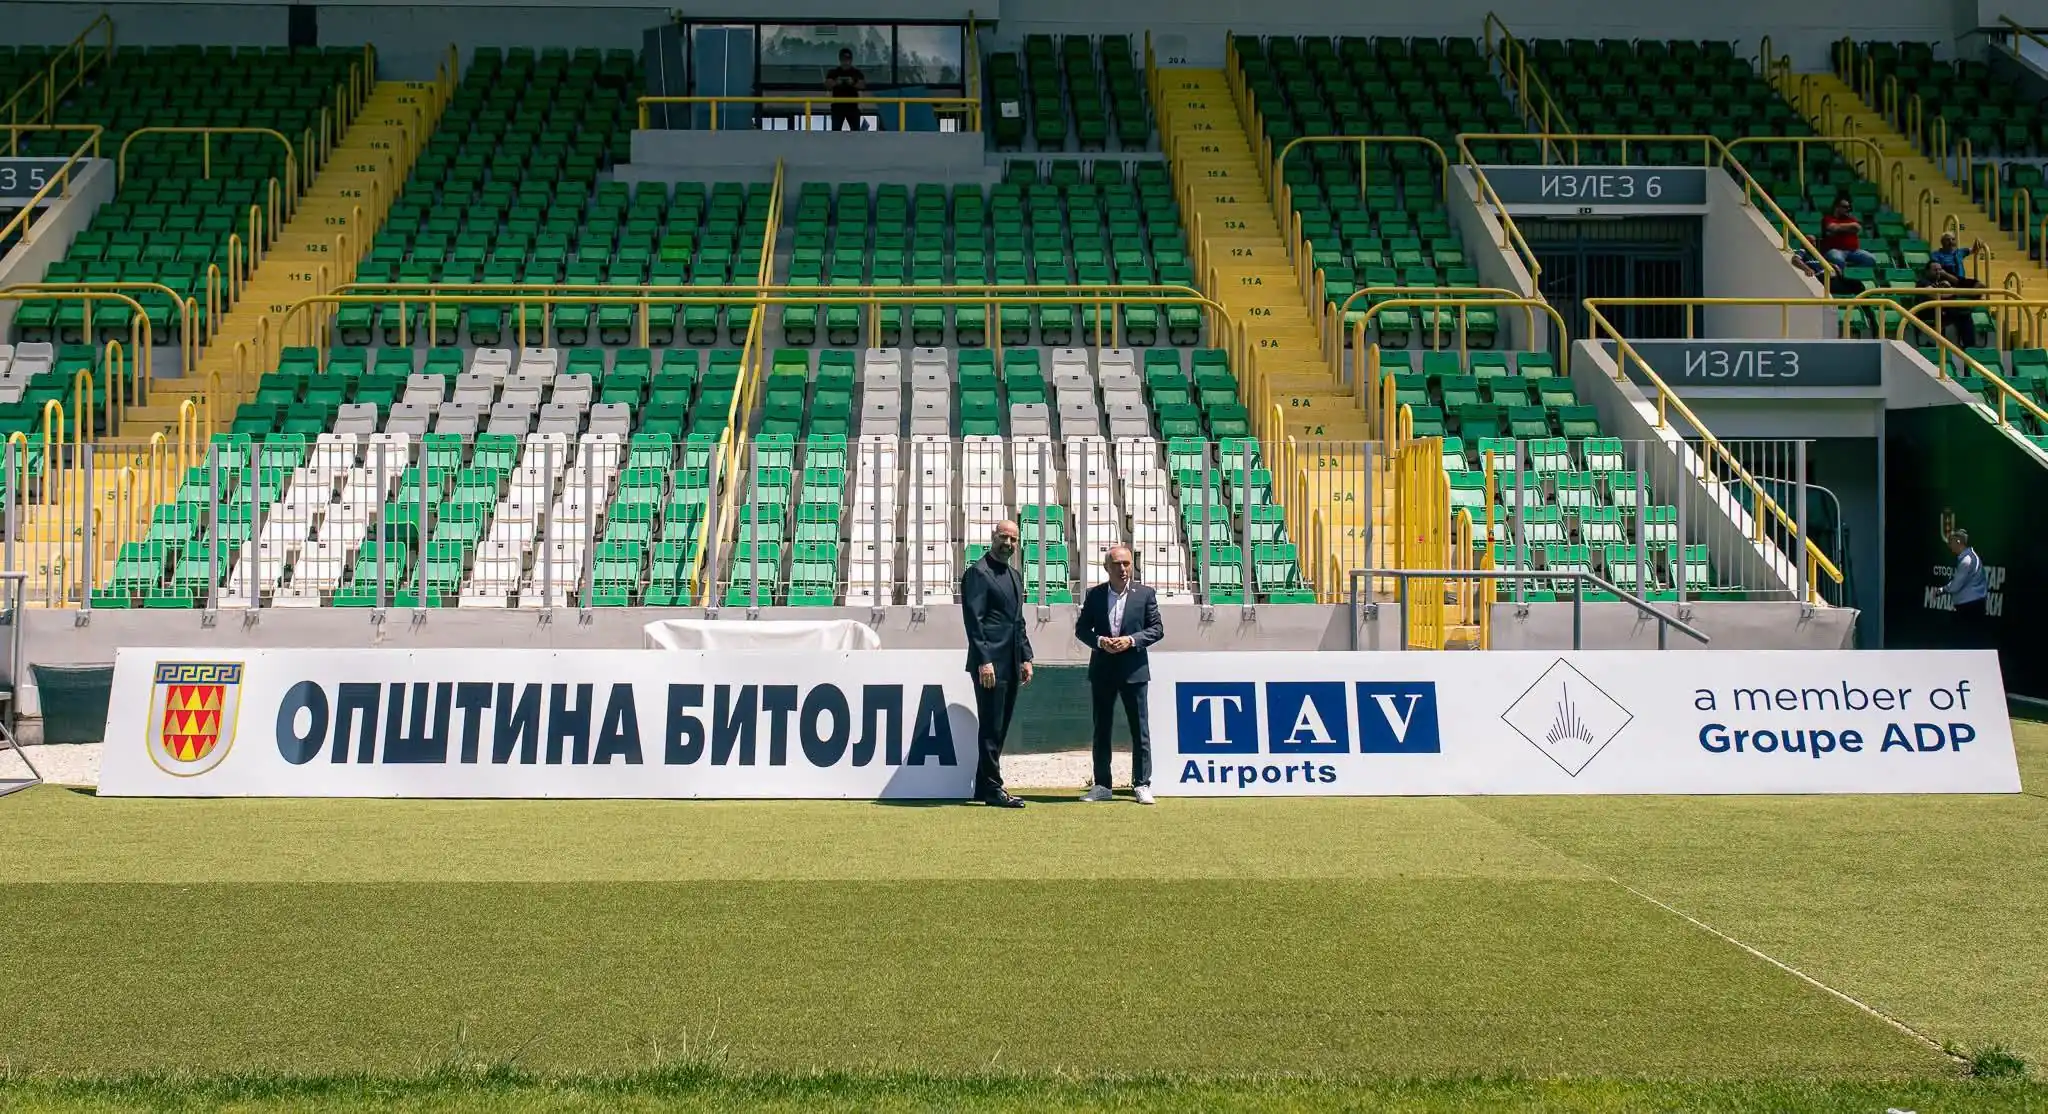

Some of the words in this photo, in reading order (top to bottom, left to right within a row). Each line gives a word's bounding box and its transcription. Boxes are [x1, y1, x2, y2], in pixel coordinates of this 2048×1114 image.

[29, 168, 45, 190] 5
[1541, 175, 1634, 198] ИЗЛЕЗ
[1646, 176, 1662, 198] 6
[325, 217, 336, 225] 13
[306, 244, 317, 252] 12
[270, 305, 281, 313] 10
[1249, 308, 1260, 316] 10
[1261, 340, 1267, 348] 9
[1685, 350, 1799, 377] ИЗЛЕЗ
[1292, 398, 1299, 407] 8
[165, 426, 172, 434] 7
[1304, 426, 1311, 435] 7
[108, 491, 115, 500] 5
[1333, 493, 1340, 501] 5
[39, 566, 48, 575] 3
[1695, 689, 1717, 711] a
[1734, 681, 1912, 711] member
[1929, 680, 1971, 711] of
[1191, 693, 1423, 745] TAV
[276, 680, 644, 765] ОПШТИНА
[664, 683, 958, 768] БИТОЛА
[1699, 722, 1864, 759] Groupe
[1880, 722, 1976, 752] ADP
[1180, 760, 1337, 789] Airports
